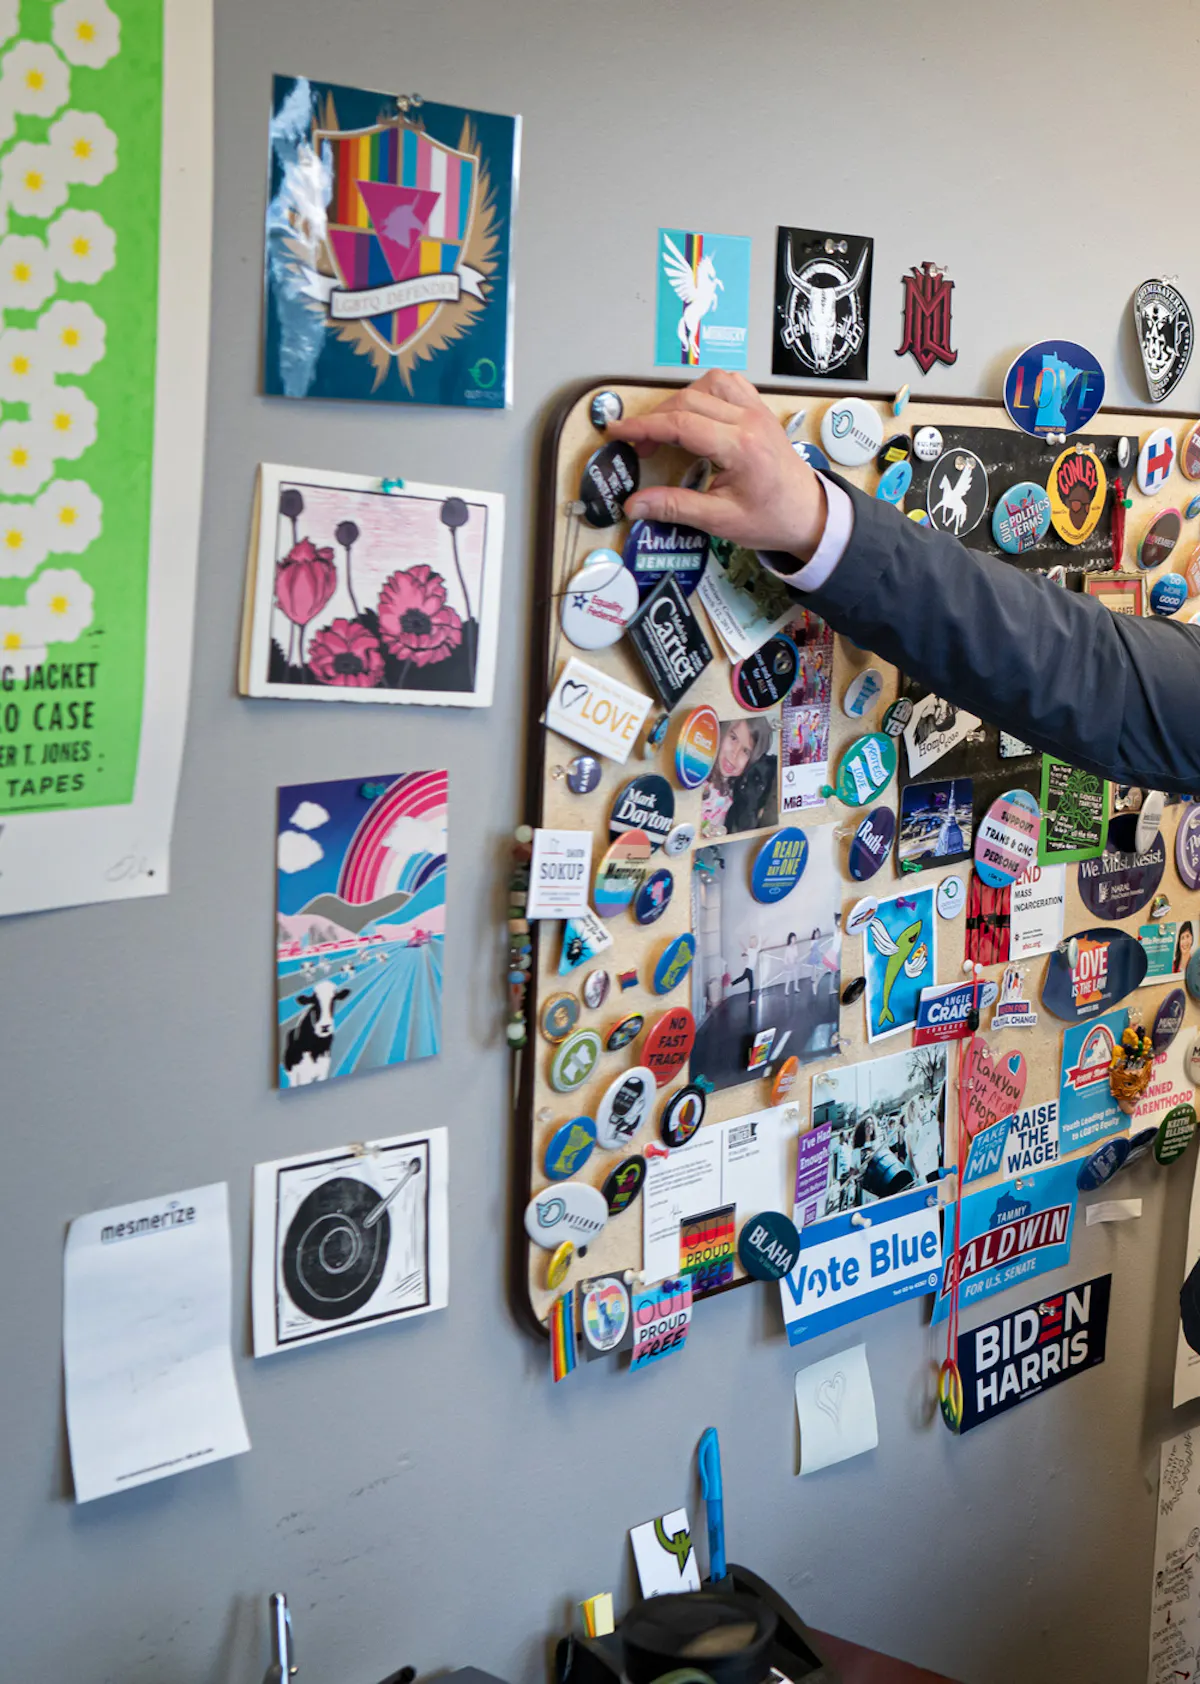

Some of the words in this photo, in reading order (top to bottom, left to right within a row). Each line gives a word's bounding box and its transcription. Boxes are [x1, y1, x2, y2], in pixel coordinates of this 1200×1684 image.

[1012, 364, 1099, 411] LOVE
[1058, 455, 1099, 496] CONLEY
[1009, 497, 1050, 529] POLITICS
[636, 525, 704, 551] Andrea
[999, 520, 1013, 543] OUR
[1010, 513, 1044, 540] TERMS
[636, 555, 701, 569] JENKINS
[1159, 594, 1180, 605] GOOD
[649, 597, 696, 684] Carter
[23, 661, 99, 692] JACKET
[0, 703, 20, 734] O
[33, 700, 95, 732] CASE
[580, 691, 641, 741] LOVE
[41, 739, 92, 766] JONES
[866, 740, 887, 782] PROTECT
[6, 773, 85, 798] TAPES
[626, 787, 657, 808] Mark
[616, 799, 674, 830] Dayton
[784, 794, 802, 810] Mia
[1000, 811, 1035, 834] SUPPORT
[772, 840, 806, 858] READY
[857, 819, 883, 855] Ruth
[985, 826, 1010, 846] TRANS
[540, 862, 585, 881] SOKUP
[778, 858, 801, 876] ONE
[983, 847, 1021, 873] PERSONS
[1081, 860, 1100, 879] We.
[1132, 849, 1164, 868] Resist.
[1014, 888, 1033, 898] MASS
[1014, 895, 1063, 912] INCARCERATION
[1072, 946, 1108, 983] LOVE
[944, 993, 971, 1006] ANGIE
[1071, 984, 1079, 998] IS
[1079, 980, 1093, 995] THE
[927, 1002, 973, 1023] CRAIG
[1011, 1015, 1037, 1024] CHANGE
[1014, 1003, 1027, 1012] FOR
[669, 1016, 687, 1030] NO
[658, 1034, 688, 1048] FAST
[649, 1051, 687, 1066] TRACK
[1139, 1080, 1174, 1100] ANNED
[1133, 1090, 1194, 1118] ARENTHOOD
[1010, 1102, 1057, 1135] RAISE
[1062, 1119, 1081, 1133] Youth
[1081, 1111, 1105, 1126] Leading
[1105, 1106, 1117, 1117] the
[1072, 1132, 1079, 1140] to
[1079, 1125, 1100, 1138] LGBTQ
[1100, 1117, 1121, 1131] Equity
[1165, 1123, 1196, 1139] ELLISON
[1167, 1116, 1190, 1129] KEITH
[801, 1137, 816, 1152] I've
[816, 1126, 832, 1143] Had
[977, 1122, 1006, 1149] TAKE
[1018, 1124, 1049, 1150] THE
[967, 1144, 1001, 1180] MN
[1007, 1140, 1059, 1174] WAGE!
[100, 1202, 197, 1244] mesmerize
[996, 1204, 1028, 1226] TAMMY
[683, 1215, 731, 1250] OUT
[686, 1241, 731, 1267] PROUD
[748, 1224, 793, 1273] BLAHA
[945, 1208, 1068, 1294] BALDWIN
[781, 1253, 860, 1306] Vote
[870, 1230, 937, 1279] Blue
[964, 1279, 985, 1299] FOR
[984, 1272, 1002, 1292] U.S.
[1003, 1257, 1037, 1286] SENATE
[637, 1284, 689, 1326] OUT
[640, 1312, 687, 1342] PROUD
[975, 1284, 1093, 1374] BIDEN
[637, 1327, 686, 1364] FREE
[976, 1330, 1089, 1415] HARRIS
